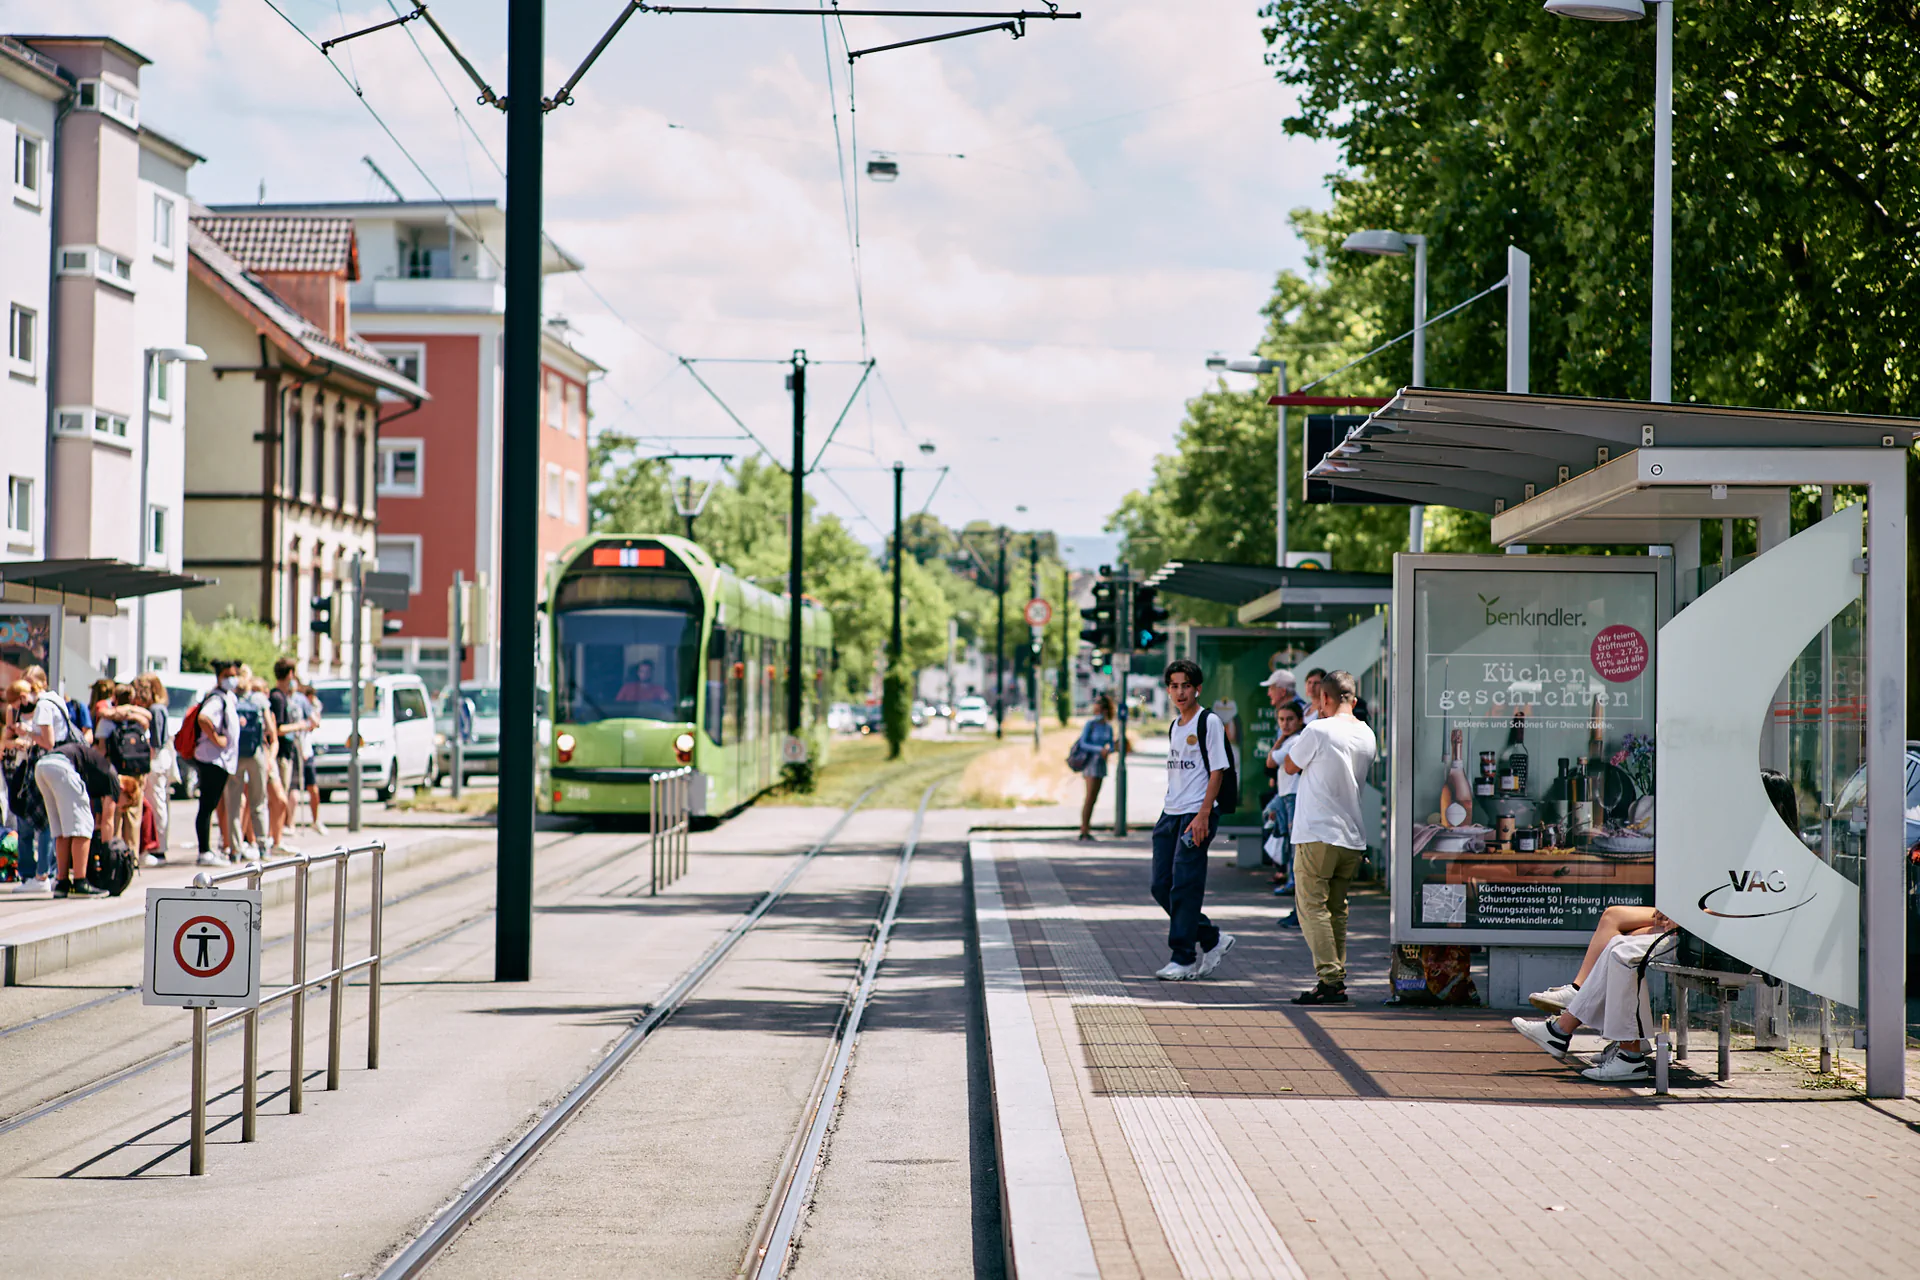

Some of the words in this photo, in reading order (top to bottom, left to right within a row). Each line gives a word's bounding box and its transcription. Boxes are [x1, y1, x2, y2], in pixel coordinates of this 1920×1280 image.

[1486, 608, 1587, 626] benkindler.
[1598, 635, 1611, 643] Wir
[1613, 631, 1636, 640] feiern
[1597, 639, 1638, 651] Eröffnung!
[1621, 646, 1644, 656] 2.7.22
[1598, 659, 1615, 668] 10%
[1616, 656, 1629, 665] auf
[1631, 654, 1645, 663] alle
[1483, 663, 1585, 683] Küchen
[1603, 663, 1641, 676] Produkte!
[1439, 687, 1629, 710] geschichten
[1453, 720, 1489, 729] Leckeres
[1491, 720, 1508, 729] und
[1509, 720, 1544, 729] Schönes
[1545, 720, 1559, 729] für
[1560, 720, 1585, 729] Deine
[1586, 720, 1615, 730] Küche.
[1729, 870, 1787, 893] VAG
[1478, 884, 1562, 895] Küchengeschichten
[1478, 895, 1545, 904] Schusterstrasse
[1547, 895, 1558, 904] 50
[1564, 896, 1601, 906] Freiburg
[1607, 896, 1643, 905] Altstadt
[1478, 905, 1546, 915] Öffnungszeiten
[1478, 916, 1564, 925] www.benkindler.de
